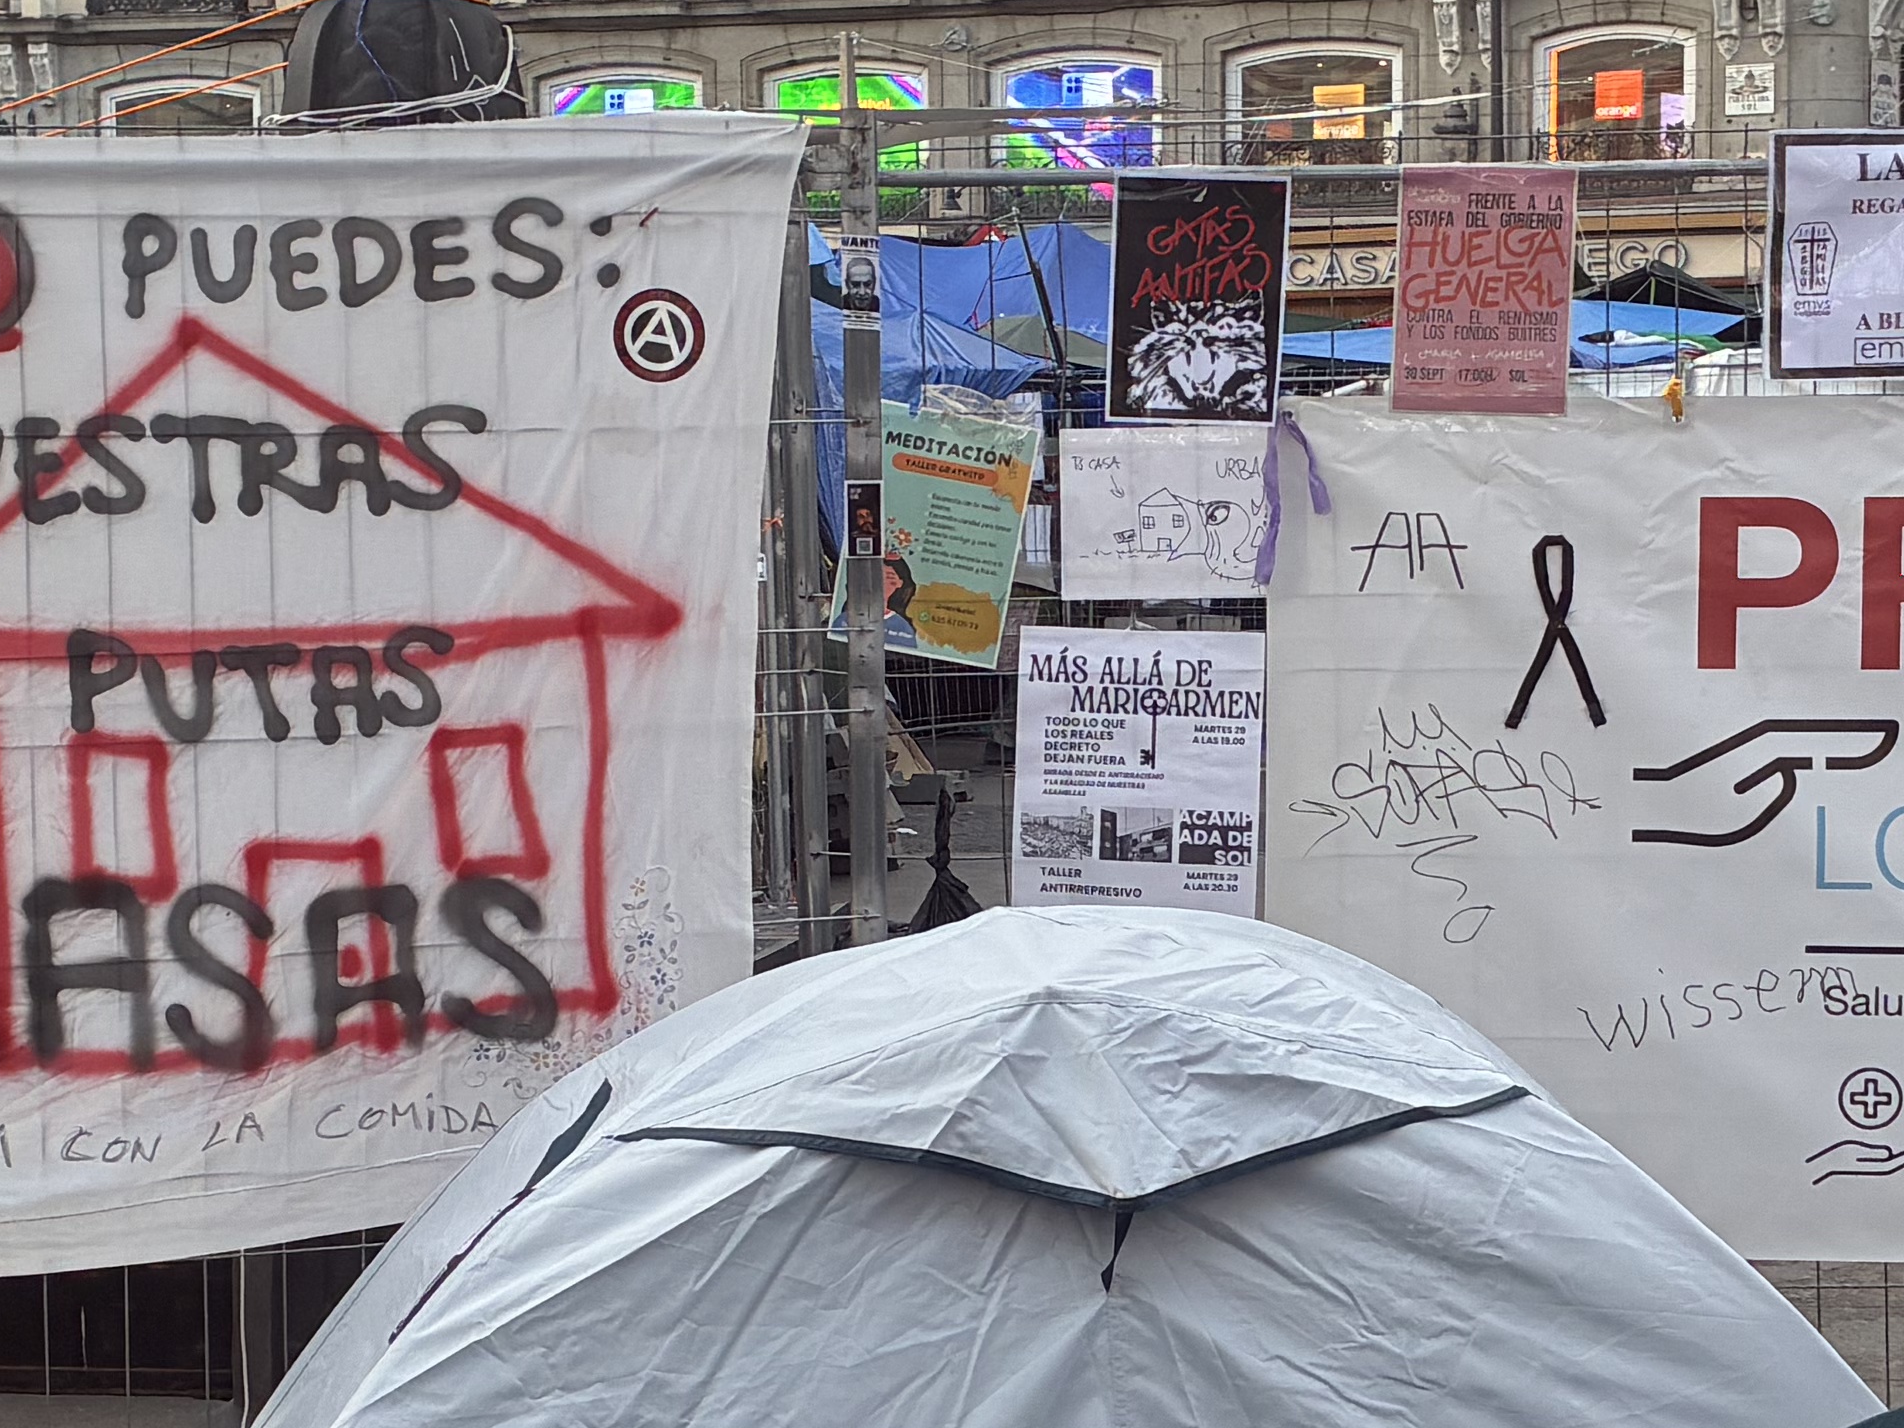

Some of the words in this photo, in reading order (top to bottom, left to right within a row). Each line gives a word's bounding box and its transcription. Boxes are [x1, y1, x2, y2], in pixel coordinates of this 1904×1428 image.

[1596, 104, 1639, 119] orange
[1468, 193, 1516, 210] FRENTE
[1527, 195, 1536, 210] A
[1548, 195, 1564, 211] LA
[1407, 210, 1454, 227] ESTAFA
[1466, 212, 1489, 228] DEL
[1500, 212, 1563, 230] GOBIERNO
[1147, 205, 1256, 259] GATAS
[1405, 224, 1567, 270] HUELGA
[122, 195, 624, 318] PUEDES:
[1402, 269, 1565, 314] GENERAL
[1406, 309, 1454, 323] CONTRA
[1469, 310, 1483, 325] EL
[1498, 310, 1558, 326] RENTISMO
[1855, 314, 1871, 331] A
[1406, 326, 1413, 339] Y
[1423, 326, 1446, 340] LOS
[1454, 326, 1499, 341] FONDOS
[1507, 327, 1557, 342] BUITRES
[1420, 368, 1446, 380] SEPT
[1508, 369, 1528, 383] SOL
[884, 429, 1013, 468] MEDITACIÓN
[1088, 455, 1121, 471] CASA
[1029, 646, 1088, 684] MÁS
[1099, 650, 1164, 687] ALLÁ
[1176, 659, 1213, 687] DE
[65, 624, 455, 745] PUTAS
[1045, 716, 1080, 728] TODO
[1083, 717, 1099, 728] LO
[1101, 718, 1126, 730] QUE
[1194, 724, 1233, 734] MARTES
[1044, 729, 1068, 739] LOS
[1070, 730, 1114, 741] REALES
[1192, 735, 1200, 744] A
[1201, 736, 1219, 745] LAS
[1044, 741, 1101, 753] DECRETO
[1044, 753, 1085, 765] DEJAN
[1087, 754, 1127, 766] FUERA
[1179, 829, 1223, 846] ADA
[1214, 850, 1252, 866] SOL
[1040, 866, 1082, 879] TALLER
[1186, 871, 1225, 882] MARTES
[1039, 883, 1143, 899] ANTIRREPRESIVO
[61, 1126, 163, 1165] CON
[201, 1112, 265, 1153] LA
